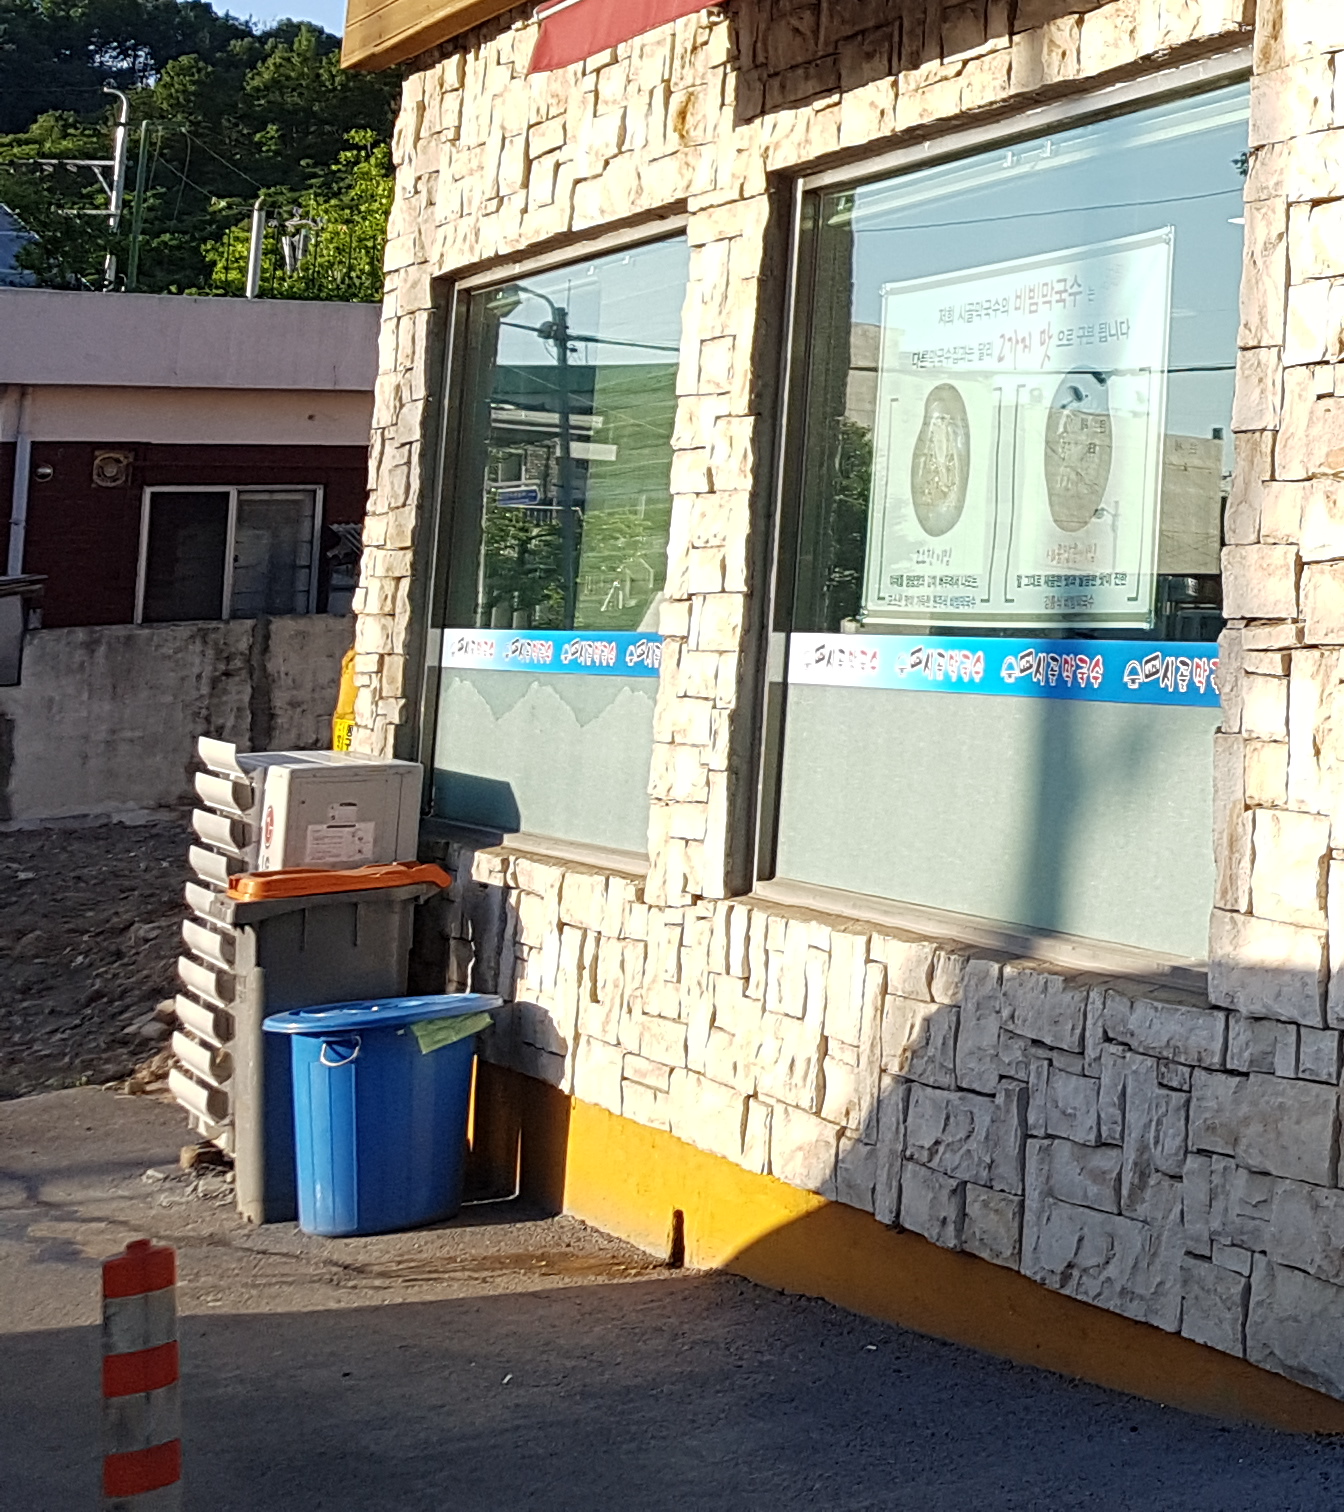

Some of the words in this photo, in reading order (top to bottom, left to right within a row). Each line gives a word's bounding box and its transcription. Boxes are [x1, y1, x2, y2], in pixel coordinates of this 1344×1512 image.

[938, 305, 955, 327] 저희
[957, 295, 1010, 324] 시골막국수의
[1014, 274, 1083, 315] 비빔막국수
[997, 328, 1032, 370] 2가지
[1056, 328, 1074, 348] 으로
